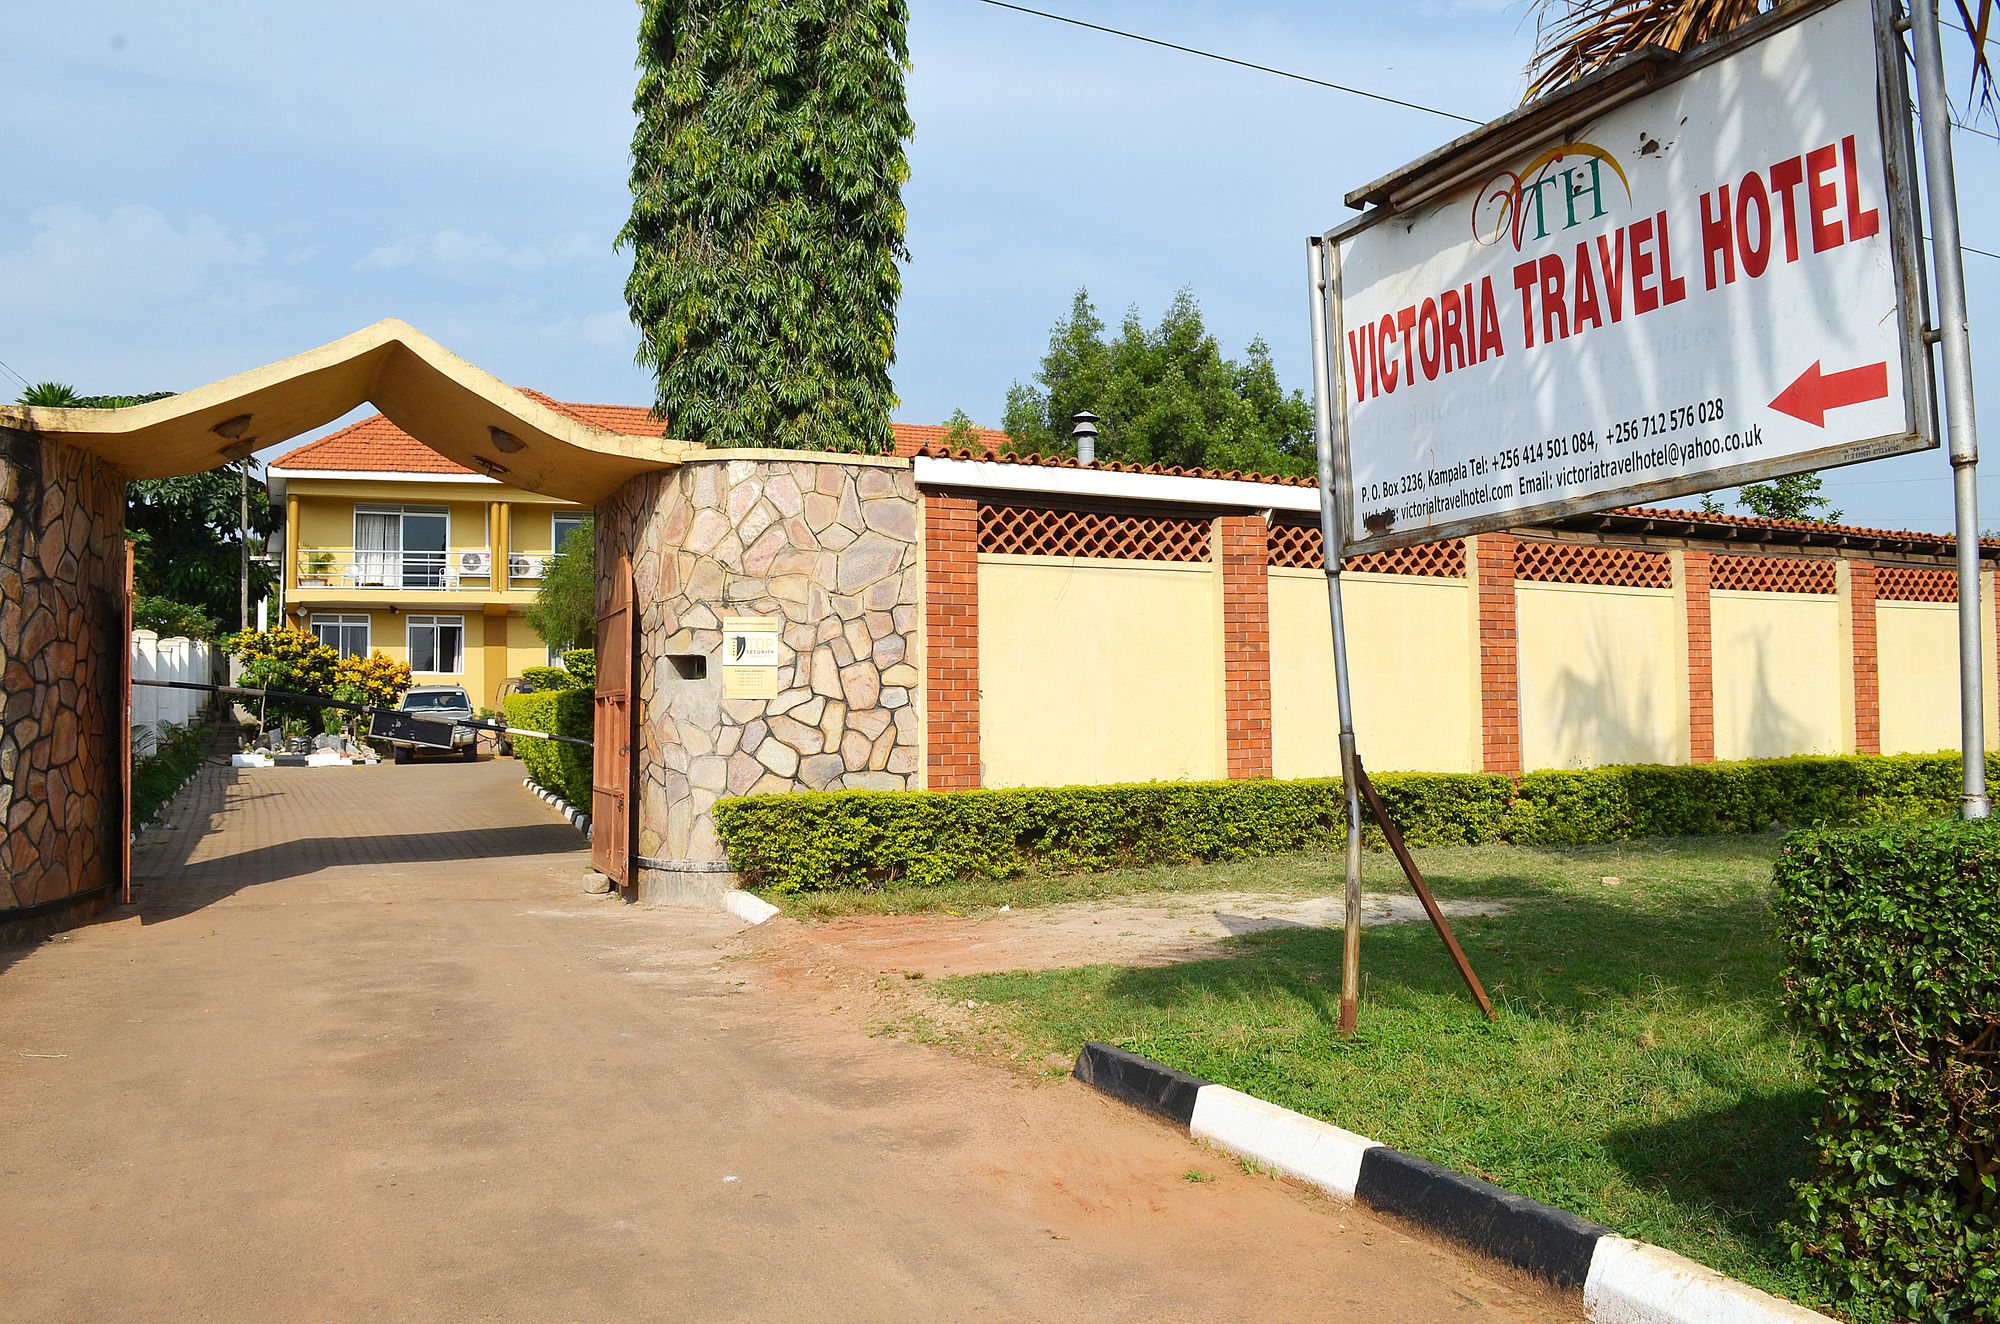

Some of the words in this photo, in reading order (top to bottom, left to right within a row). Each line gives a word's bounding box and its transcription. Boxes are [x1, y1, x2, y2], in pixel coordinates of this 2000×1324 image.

[1348, 275, 1504, 403] VICTORIA
[1513, 210, 1686, 349] TRAVEL
[1700, 135, 1880, 291] HOTEL
[1362, 487, 1369, 503] P.
[1372, 484, 1380, 500] O.
[1383, 482, 1399, 497] Box
[1401, 472, 1425, 493] 3236,
[1428, 462, 1467, 487] Kampala
[1469, 456, 1488, 476] Tel:
[1492, 448, 1519, 471] +256
[1523, 443, 1543, 464] 414
[1547, 437, 1568, 459] 501
[1572, 431, 1598, 453] 084,
[1606, 420, 1638, 445] +256
[1642, 413, 1666, 437] 712
[1671, 405, 1694, 430] 576
[1699, 398, 1723, 423] 028
[1401, 484, 1513, 519] victorialtravelhotel.com
[1519, 471, 1552, 495] Email:
[1556, 424, 1762, 487] victoriatravelhotel@yahoo.co.uk
[747, 637, 775, 650] TOP
